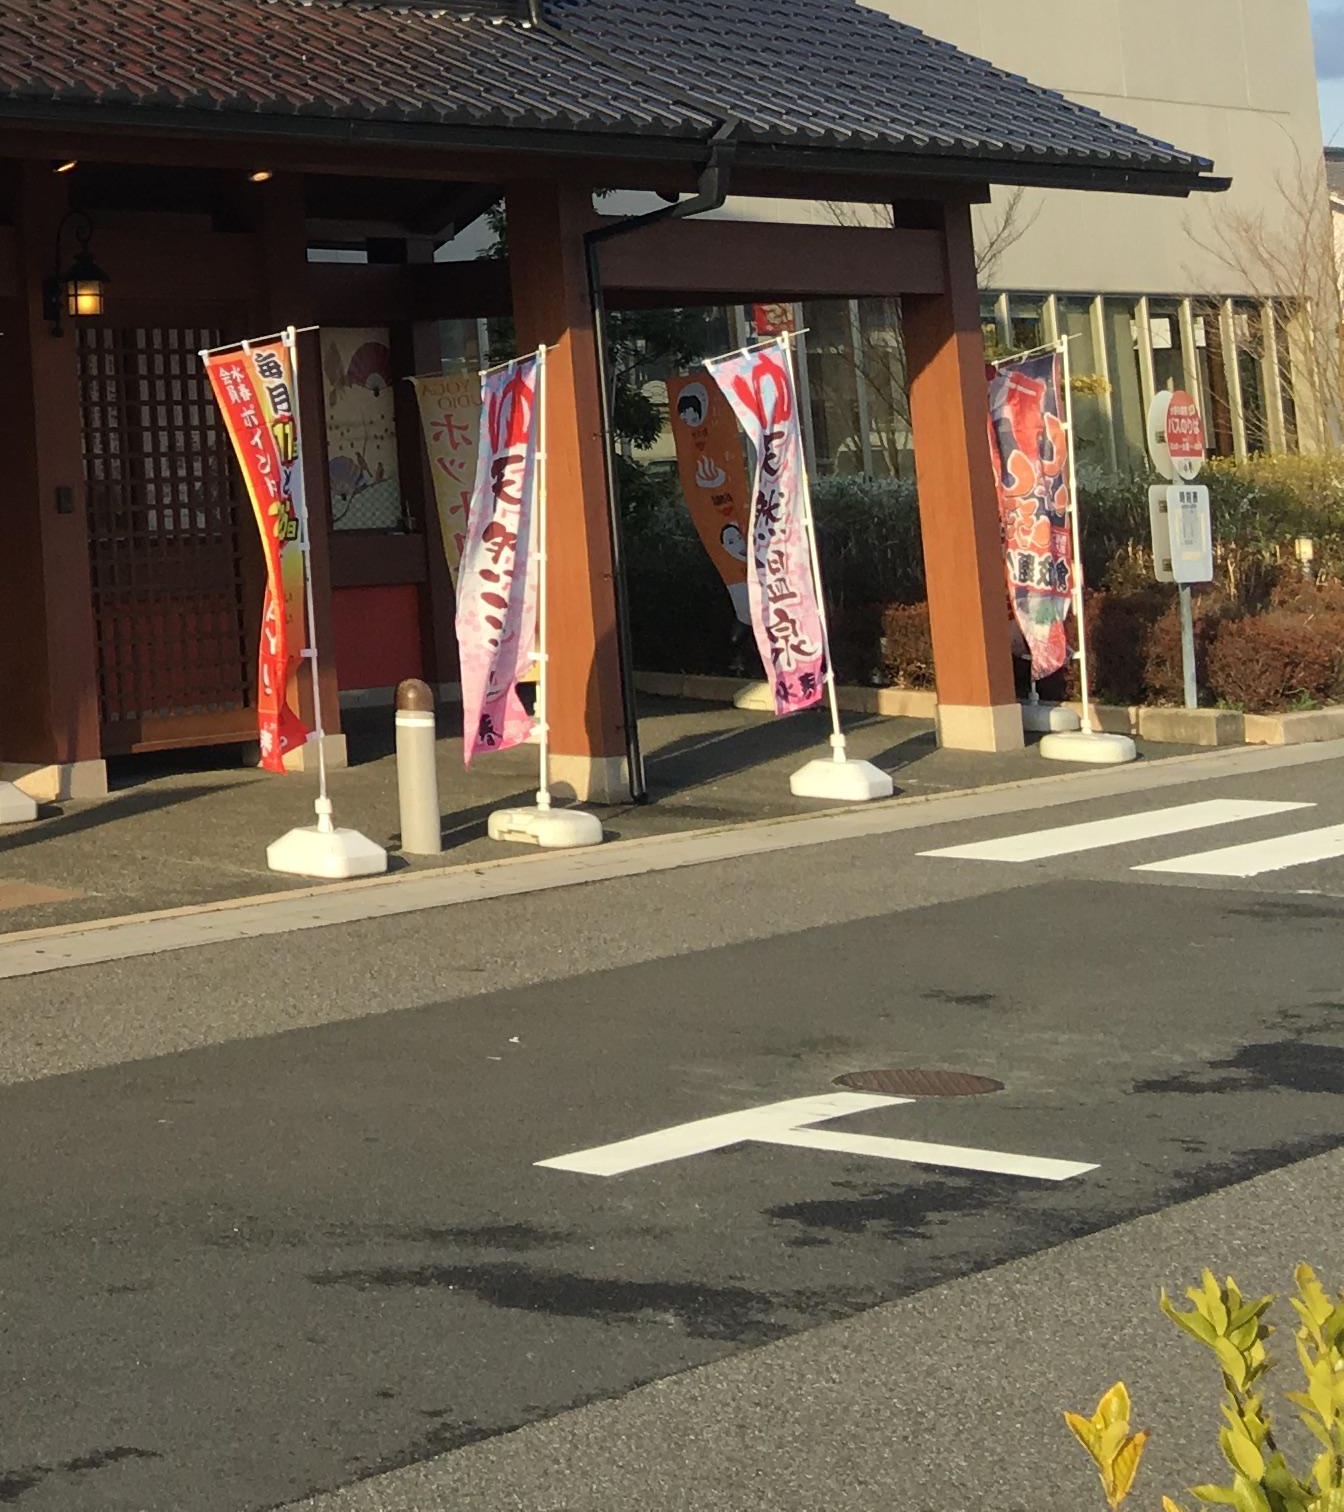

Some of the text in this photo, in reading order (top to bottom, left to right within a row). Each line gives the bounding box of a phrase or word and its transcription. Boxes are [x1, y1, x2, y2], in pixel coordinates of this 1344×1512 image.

[733, 352, 792, 429] ゆ
[1168, 417, 1201, 435] バスのりば
